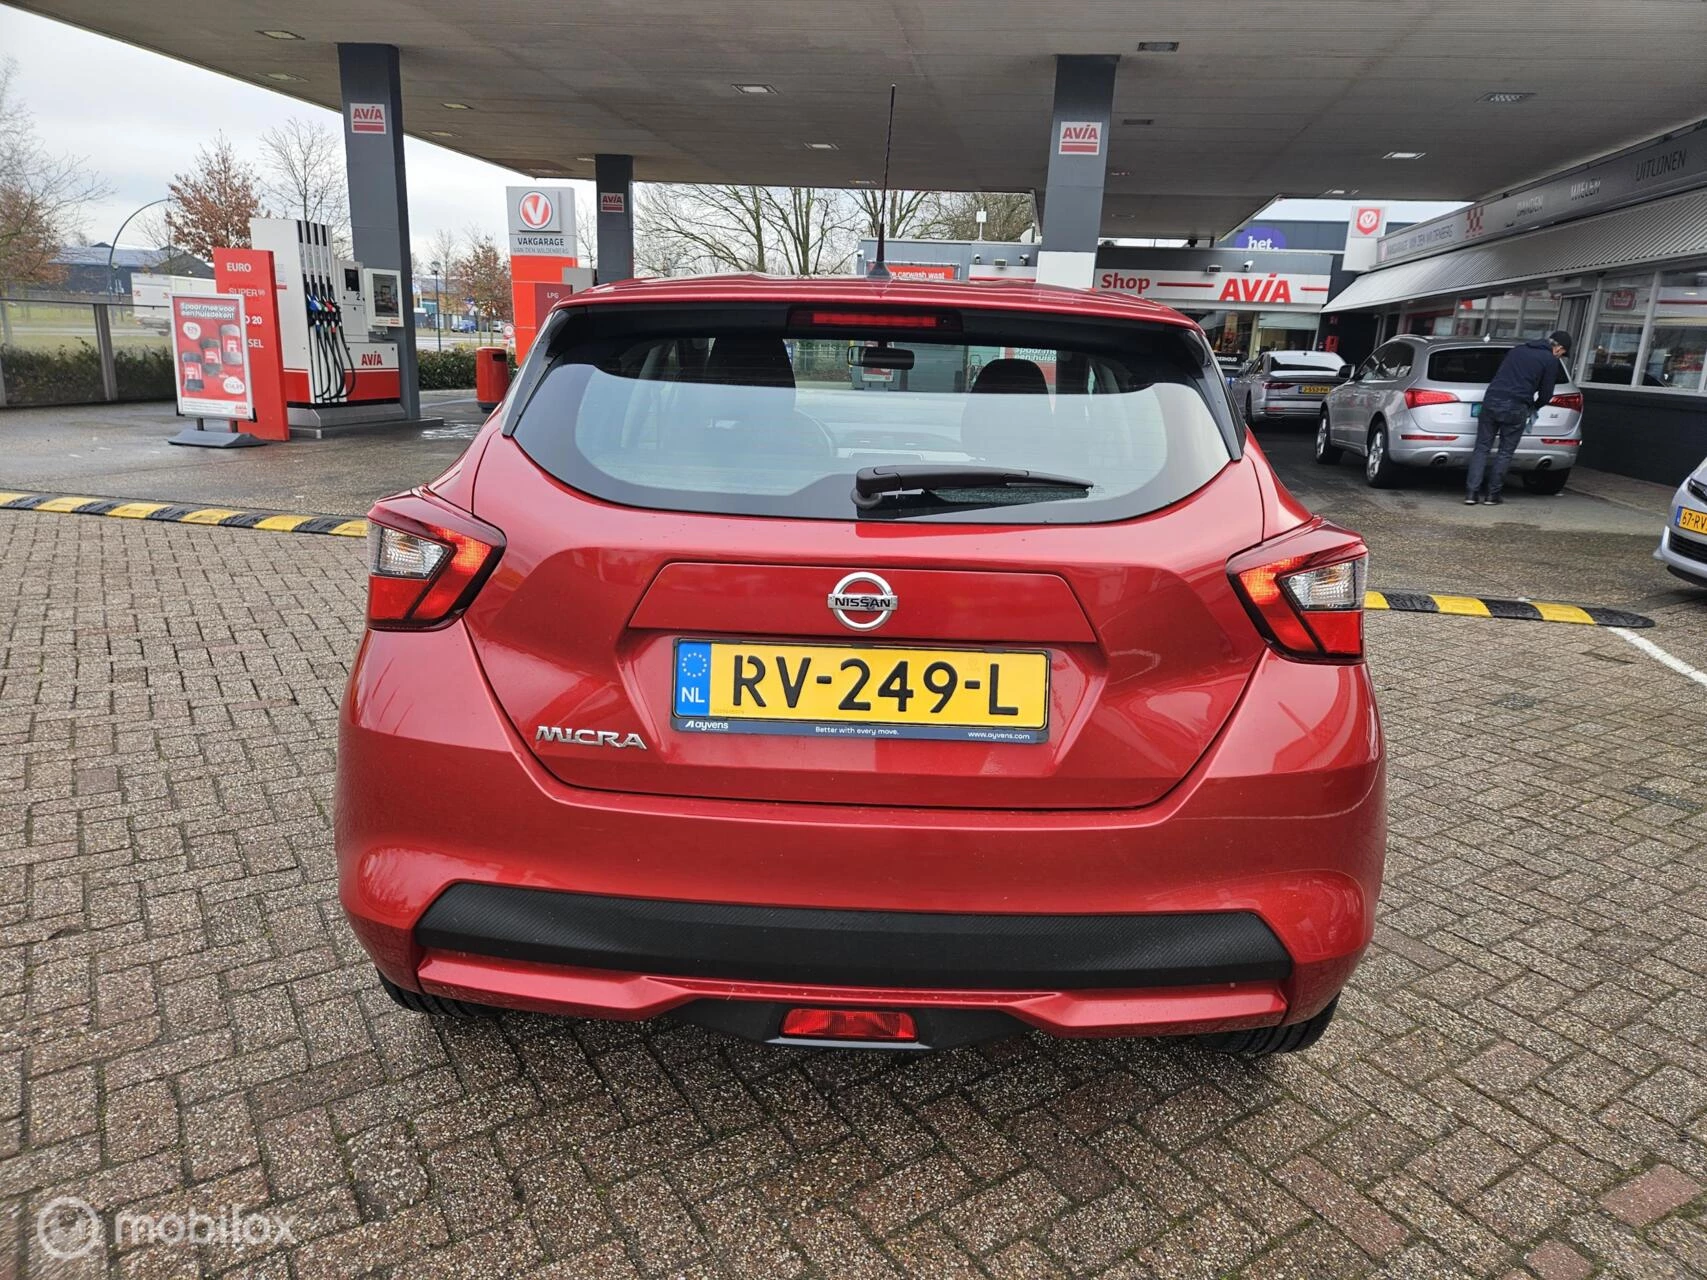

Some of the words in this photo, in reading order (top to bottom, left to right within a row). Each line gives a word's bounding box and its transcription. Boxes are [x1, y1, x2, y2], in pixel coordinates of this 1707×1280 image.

[517, 237, 565, 246] VAKGARAGE
[226, 262, 252, 272] EURO
[1101, 272, 1151, 294] Shop
[834, 597, 891, 608] NISSAN
[733, 655, 1019, 716] RV-249-L
[681, 687, 705, 703] NL
[694, 721, 729, 731] ayvens
[815, 726, 838, 735] Better
[839, 727, 855, 735] with
[856, 728, 877, 737] every
[878, 728, 900, 736] move.
[535, 725, 648, 750] MICRA
[968, 730, 1030, 740] www.ayvens.com
